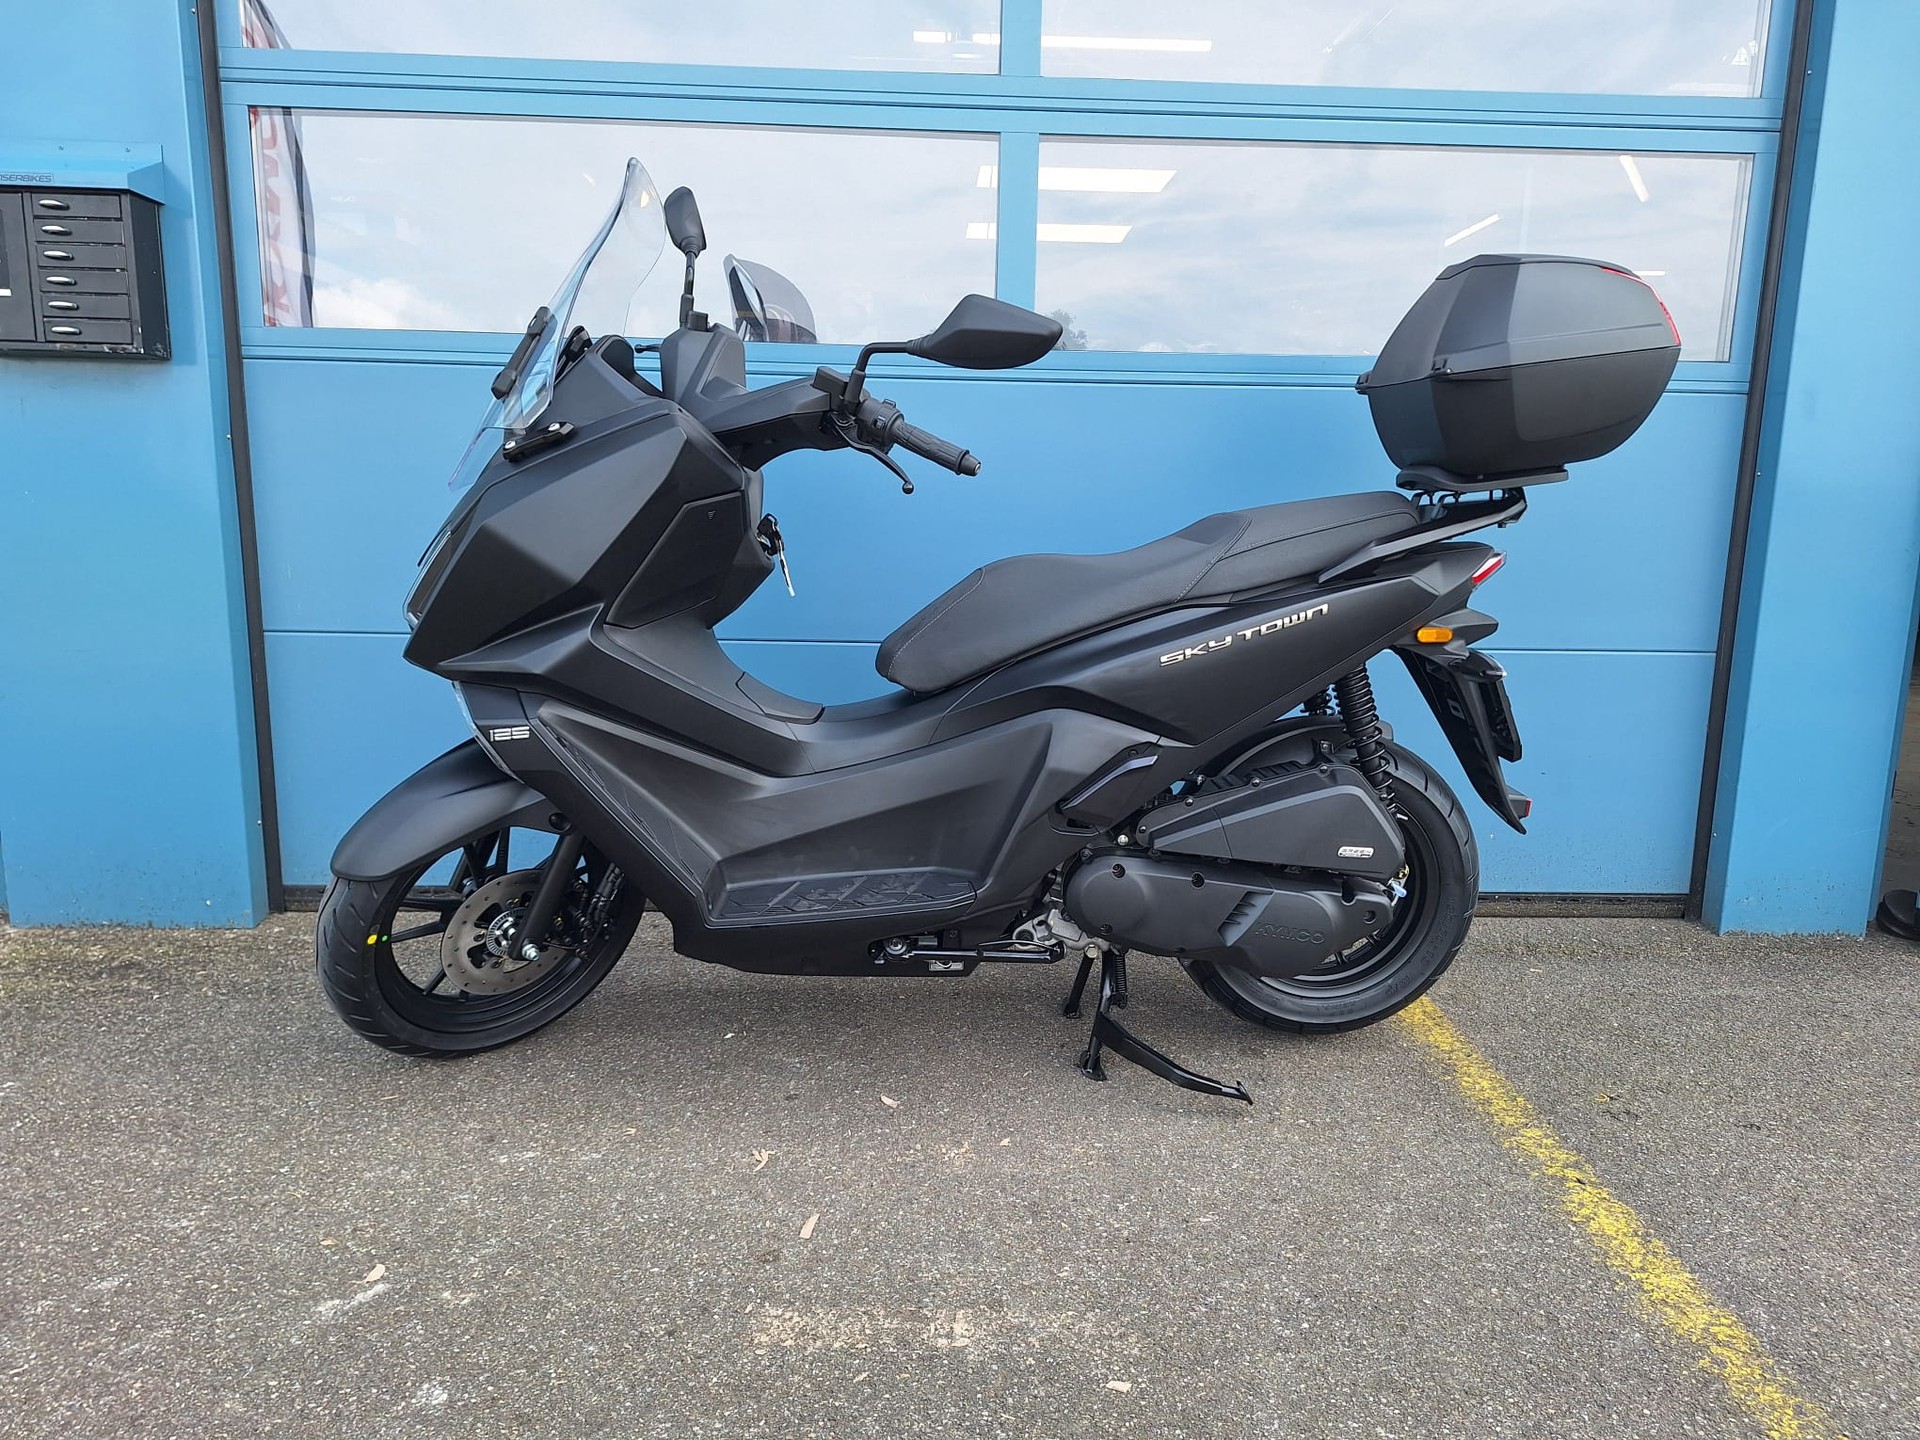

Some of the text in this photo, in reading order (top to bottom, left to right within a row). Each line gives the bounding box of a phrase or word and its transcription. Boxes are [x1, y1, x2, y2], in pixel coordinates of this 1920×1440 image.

[1159, 603, 1330, 667] SKY TOWN
[489, 726, 530, 742] 125
